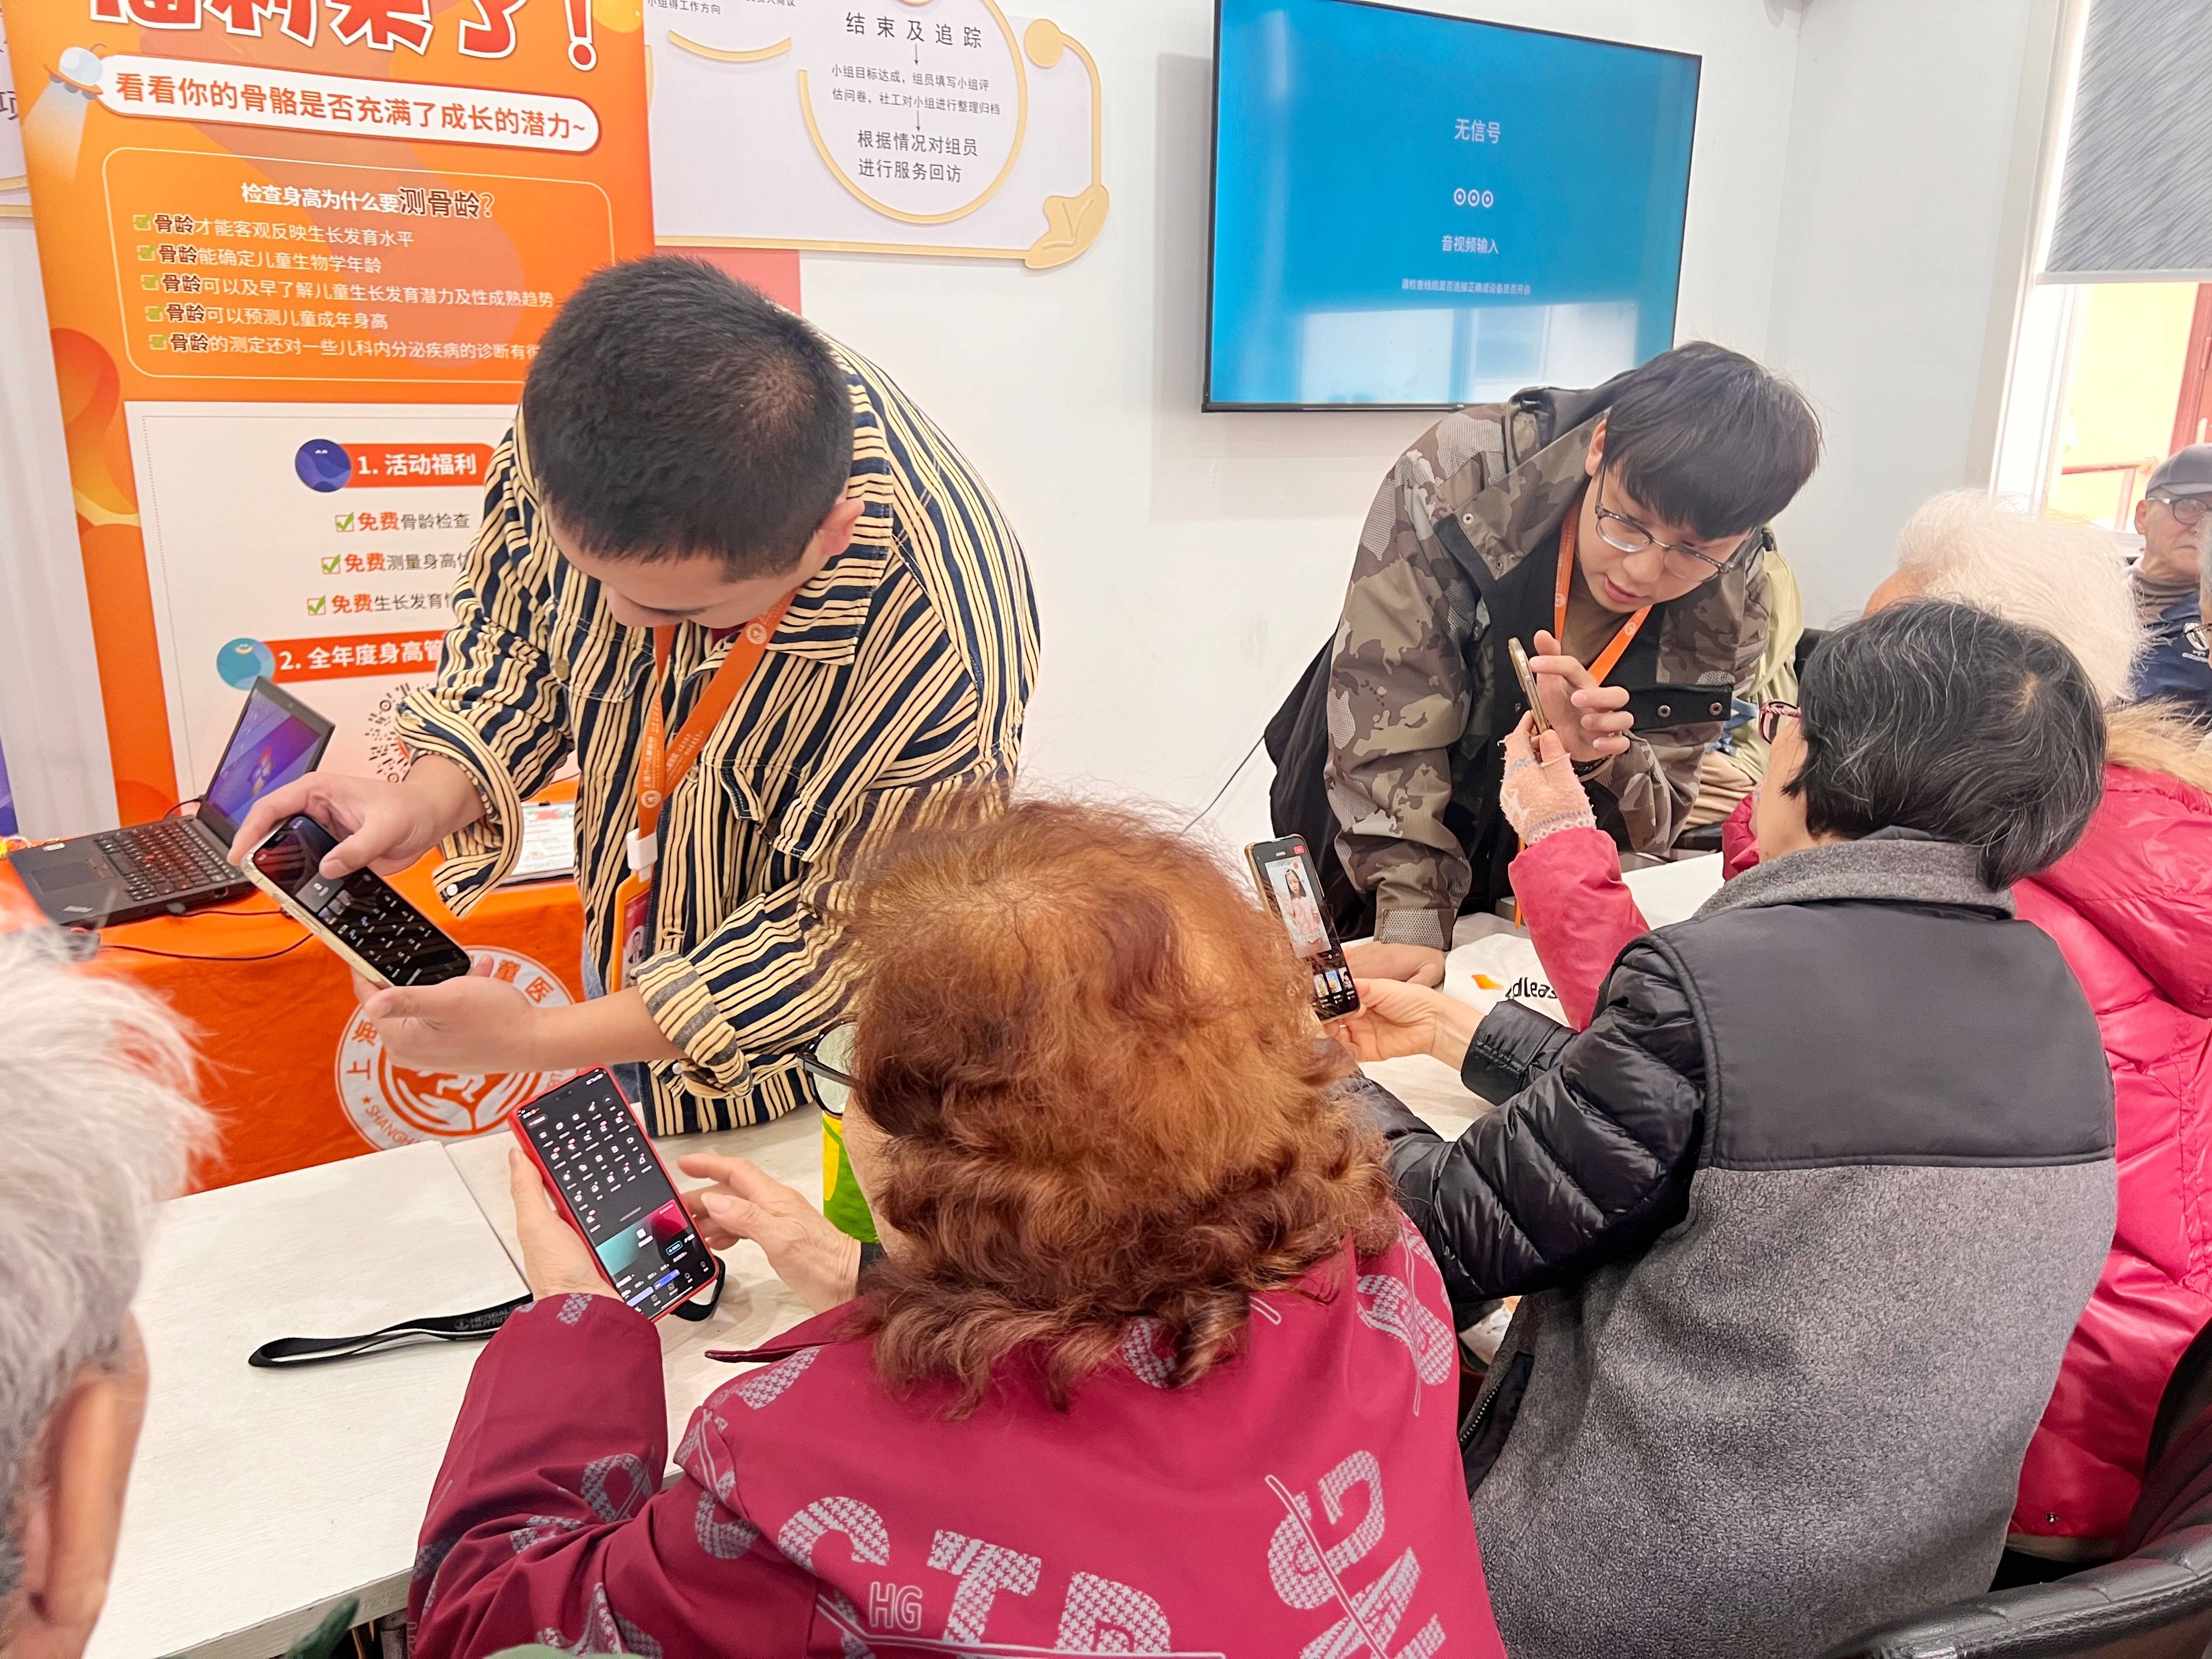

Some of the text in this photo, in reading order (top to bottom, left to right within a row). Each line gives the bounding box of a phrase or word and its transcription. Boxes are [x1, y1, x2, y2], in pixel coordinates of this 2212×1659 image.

[845, 12, 983, 49] 结束及追踪
[831, 64, 990, 92] 小组目标达成，组员填写小组评
[832, 88, 1001, 115] 估问卷，社工对小组进行整理归档
[857, 130, 979, 156] 根据情况对组员
[1454, 119, 1501, 144] 无信号
[859, 158, 962, 183] 进行服务回访
[154, 215, 414, 249] 骨龄才能客观反映生长发育水平
[1442, 235, 1499, 254] 音视频输入
[158, 245, 382, 274] 骨龄能确定儿童生物学年龄
[162, 274, 554, 308] 骨龄可以及早了解儿童生长发育潜力及性成熟趋势
[166, 304, 388, 330] 骨龄可以预测儿童成年身高
[385, 453, 477, 476] 活动福利
[358, 512, 471, 532] 免费骨龄检查
[870, 1582, 923, 1630] HG
